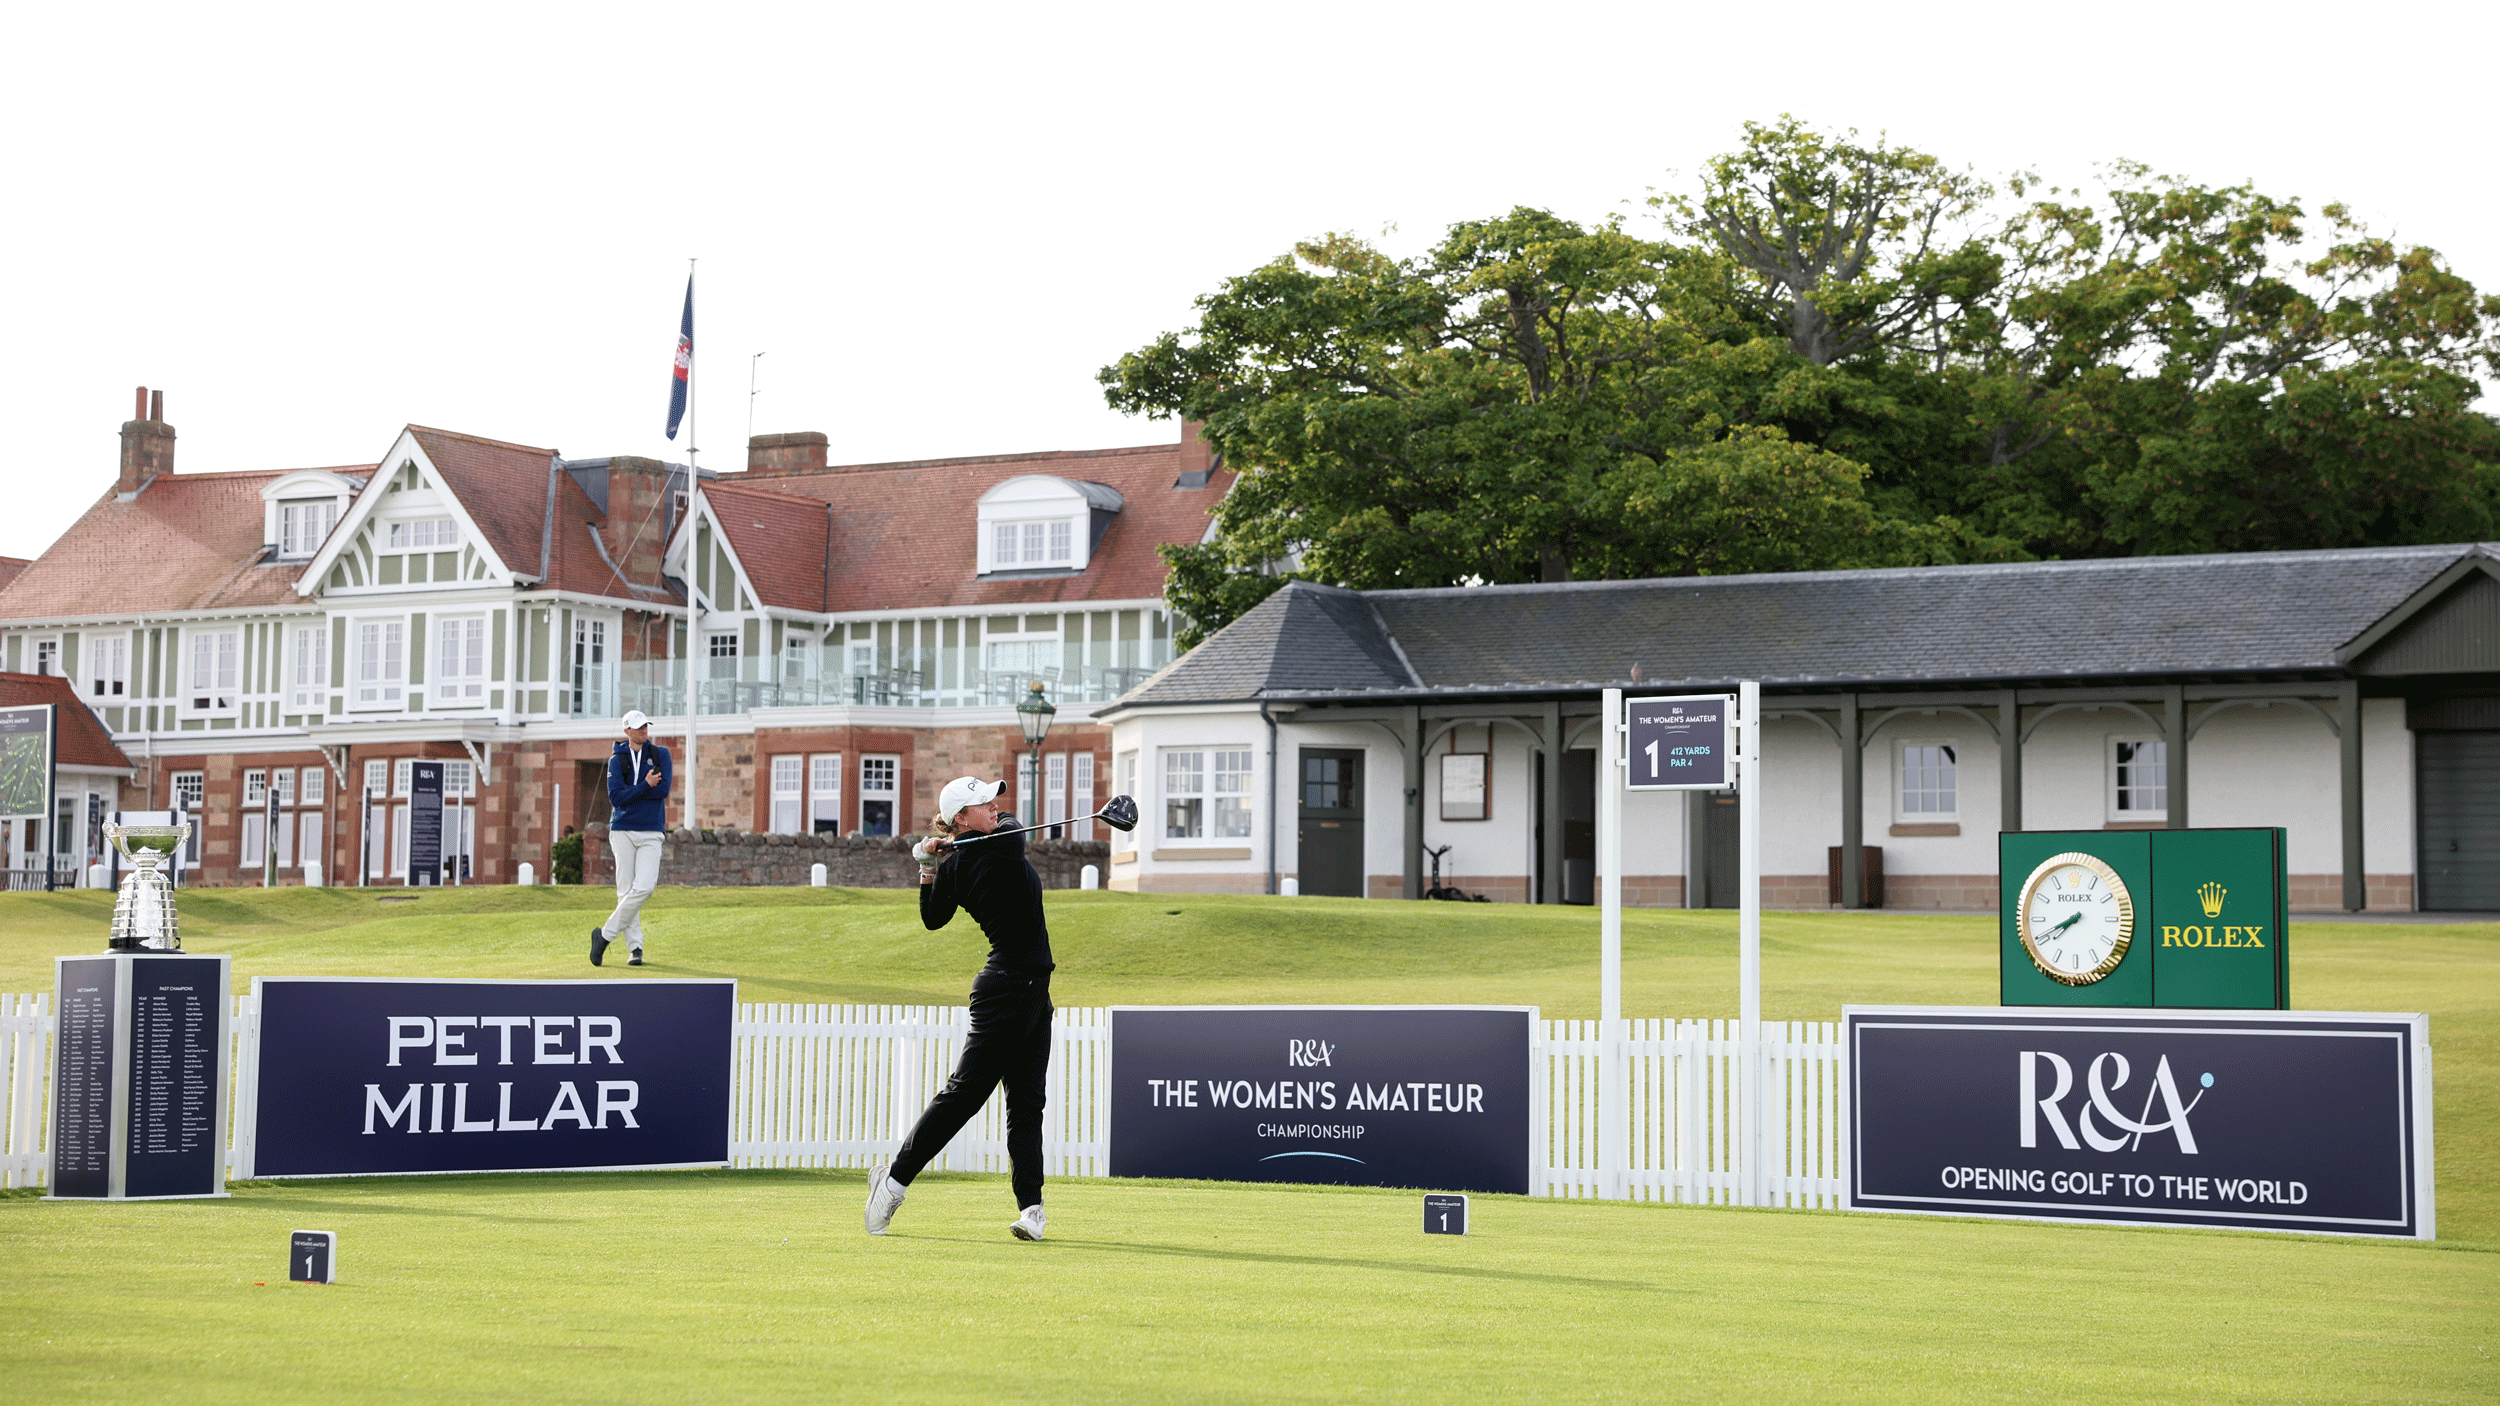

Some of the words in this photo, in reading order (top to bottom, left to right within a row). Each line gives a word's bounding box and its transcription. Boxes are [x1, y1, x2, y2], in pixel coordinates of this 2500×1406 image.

[1639, 717, 1652, 725] THE
[1653, 716, 1685, 724] WOMEN'S
[1685, 715, 1717, 723] AMATEUR
[1672, 707, 1684, 715] R&A
[1645, 739, 1659, 778] 1
[1670, 746, 1684, 756] 412
[1684, 745, 1711, 755] YARDS
[1670, 758, 1687, 767] PAR
[1688, 758, 1693, 767] 4
[2058, 894, 2092, 902] ROLEX
[2161, 925, 2265, 948] ROLEX
[386, 1016, 623, 1067] PETER
[1289, 1039, 1335, 1067] R&A
[362, 1081, 640, 1135] MILLAR
[1148, 1080, 1198, 1108] THE
[1208, 1080, 1336, 1110] WOMEN'S
[1346, 1083, 1484, 1113] AMATEUR
[2020, 1051, 2214, 1154] R&A
[1257, 1123, 1365, 1140] CHAMPIONSHIP
[1941, 1166, 2046, 1192] OPENING
[2051, 1171, 2114, 1196] GOLF
[2120, 1174, 2155, 1198] TO
[2160, 1176, 2209, 1200] THE
[2215, 1178, 2308, 1205] WORLD
[1440, 1212, 1447, 1232] 1
[305, 1255, 313, 1279] 1
